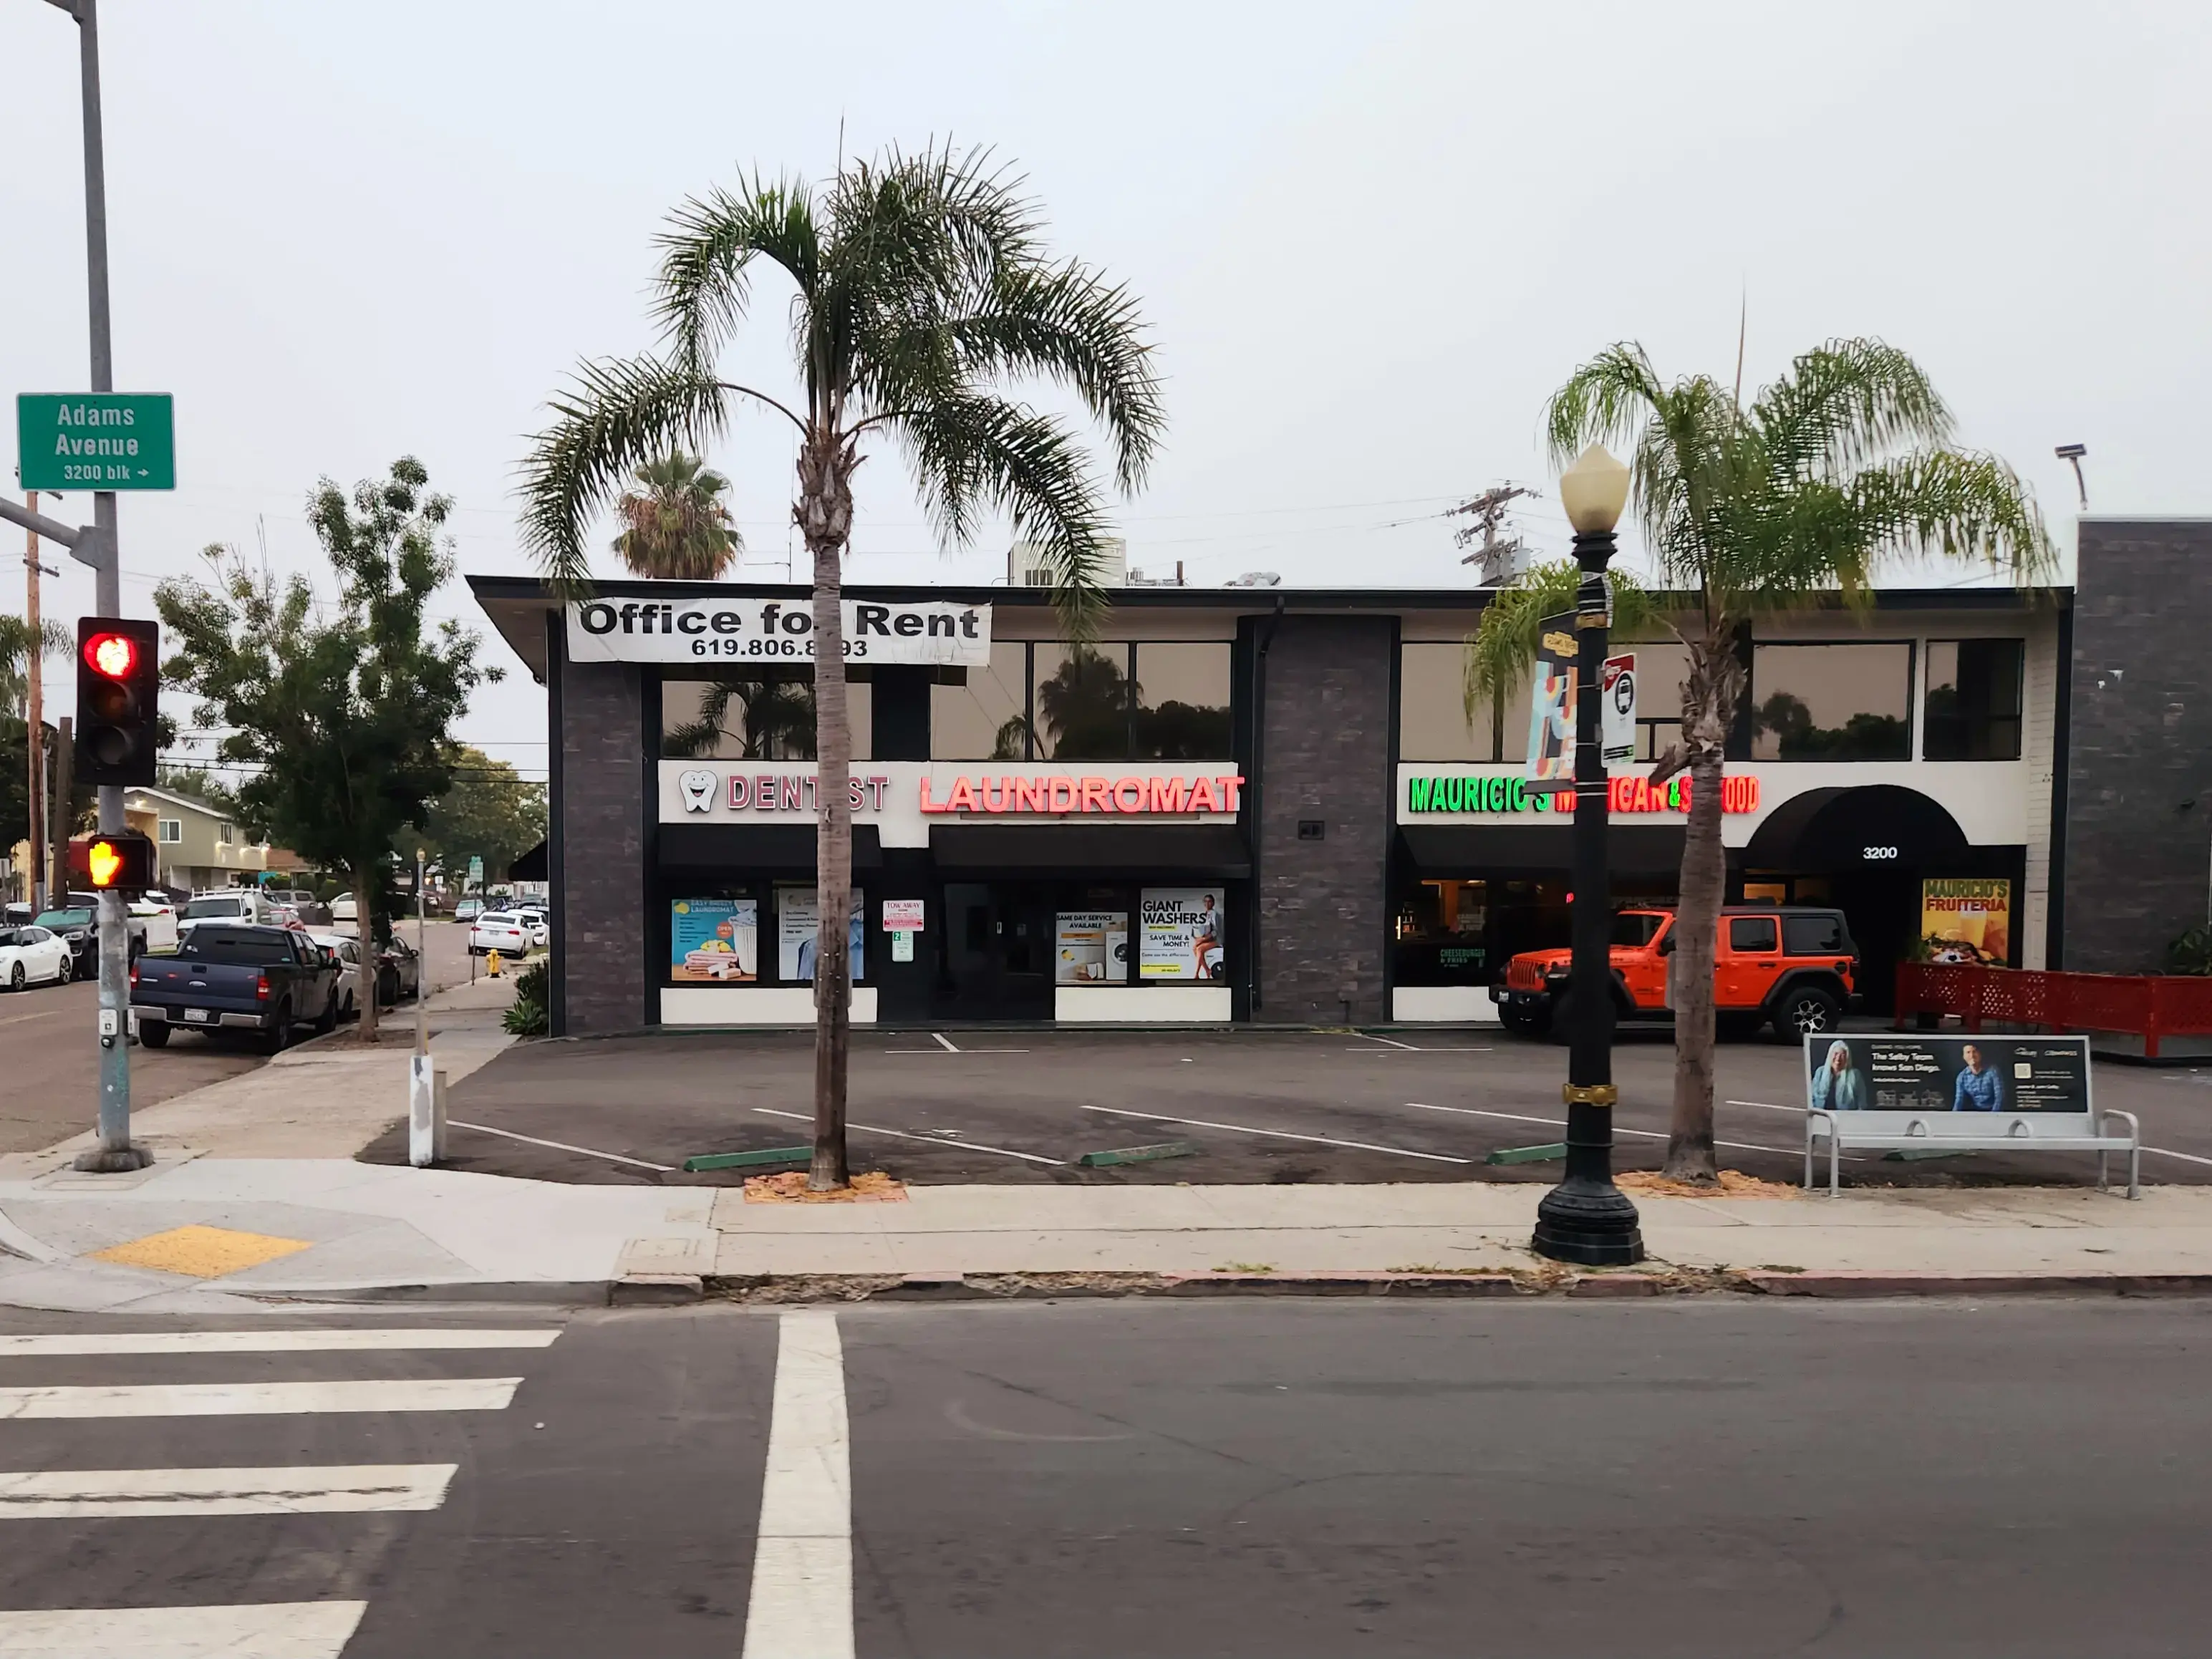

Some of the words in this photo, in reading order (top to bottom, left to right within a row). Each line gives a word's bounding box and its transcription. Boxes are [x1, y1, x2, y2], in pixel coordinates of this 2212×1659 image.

[57, 404, 135, 426] Adams
[55, 433, 138, 455] Avenue
[64, 465, 101, 480] 3200
[107, 465, 130, 480] blk
[580, 604, 741, 635] Office
[760, 604, 813, 635] fo
[856, 604, 980, 639] Rent
[692, 638, 867, 657] 619.806.893
[727, 775, 891, 811] DENTST
[919, 776, 1245, 813] LAUNDROMAT
[1863, 846, 1898, 860] 3200
[1924, 879, 2008, 898] MAURICIO'S
[1143, 900, 1183, 912] GIANT
[1926, 899, 2007, 912] FRUITERIA
[1143, 912, 1207, 924] WASHERS
